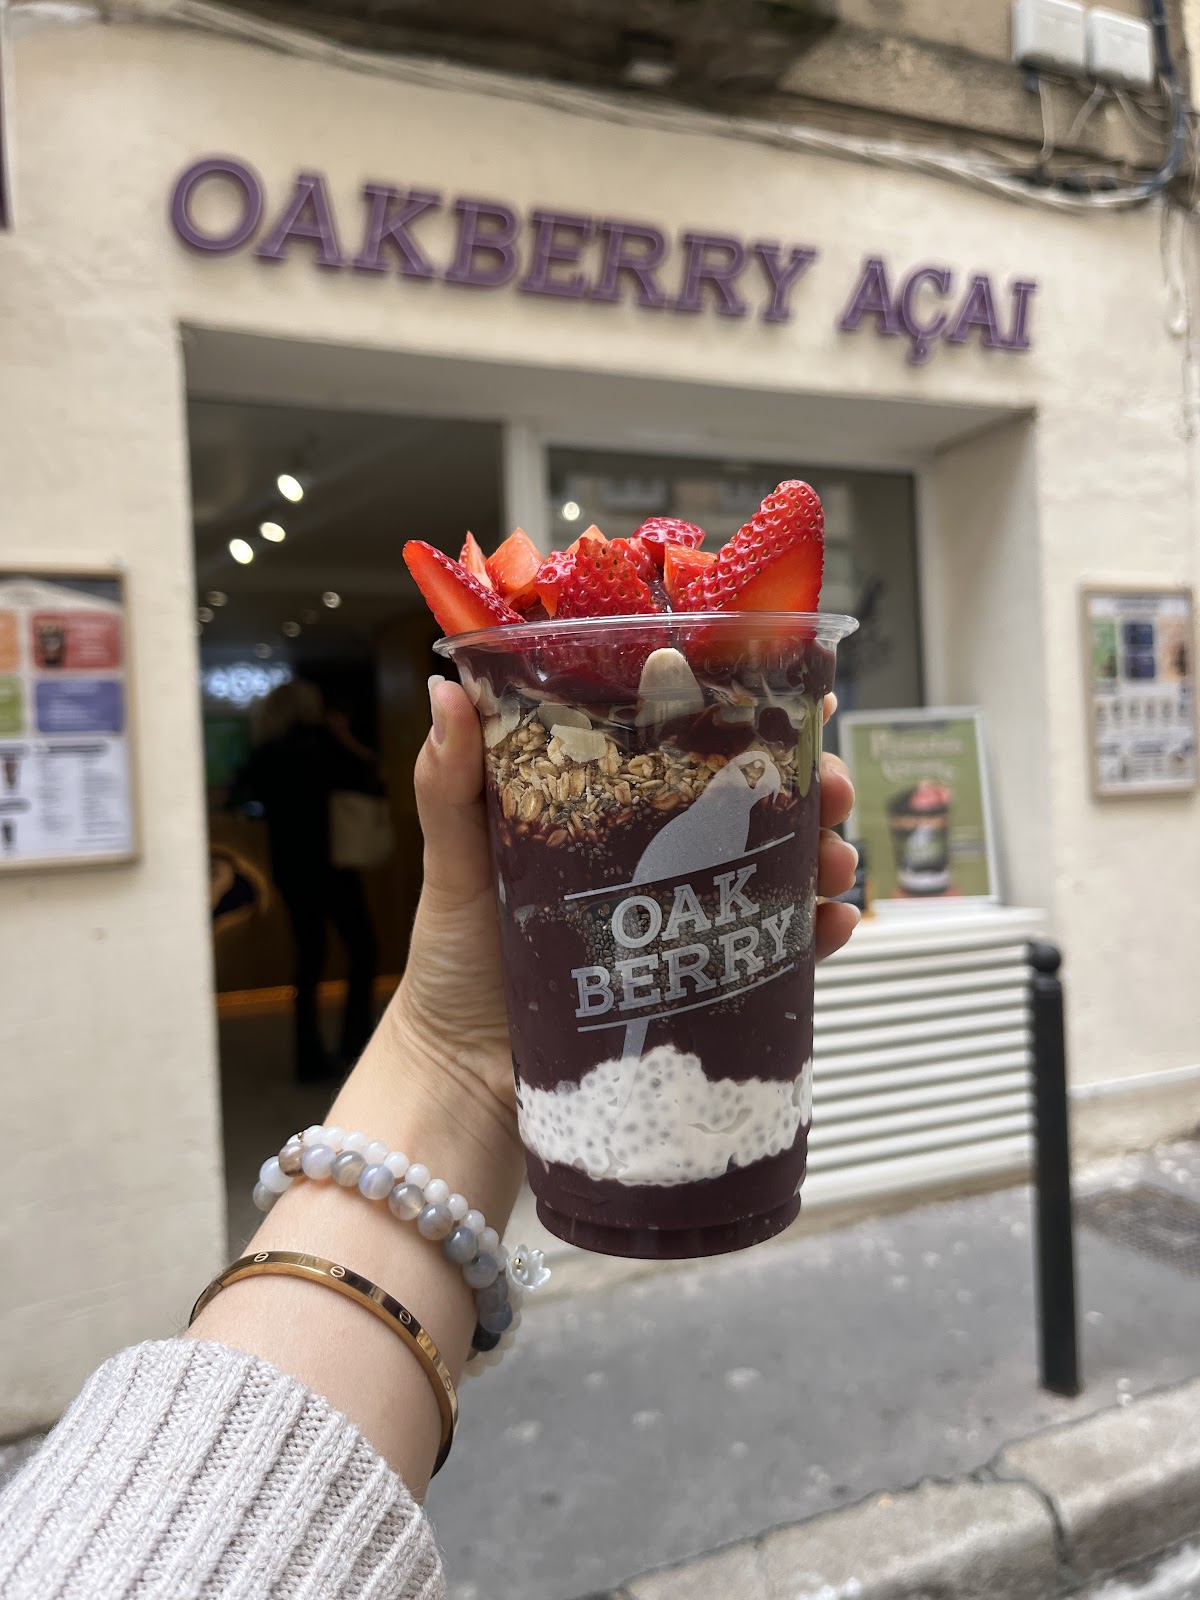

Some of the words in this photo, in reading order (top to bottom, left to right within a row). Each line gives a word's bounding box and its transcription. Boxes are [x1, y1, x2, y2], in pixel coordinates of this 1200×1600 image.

[170, 157, 817, 323] OAKBERRY
[839, 257, 1038, 363] AÇAI
[571, 904, 794, 1018] BERRY
[611, 863, 760, 949] OAK
